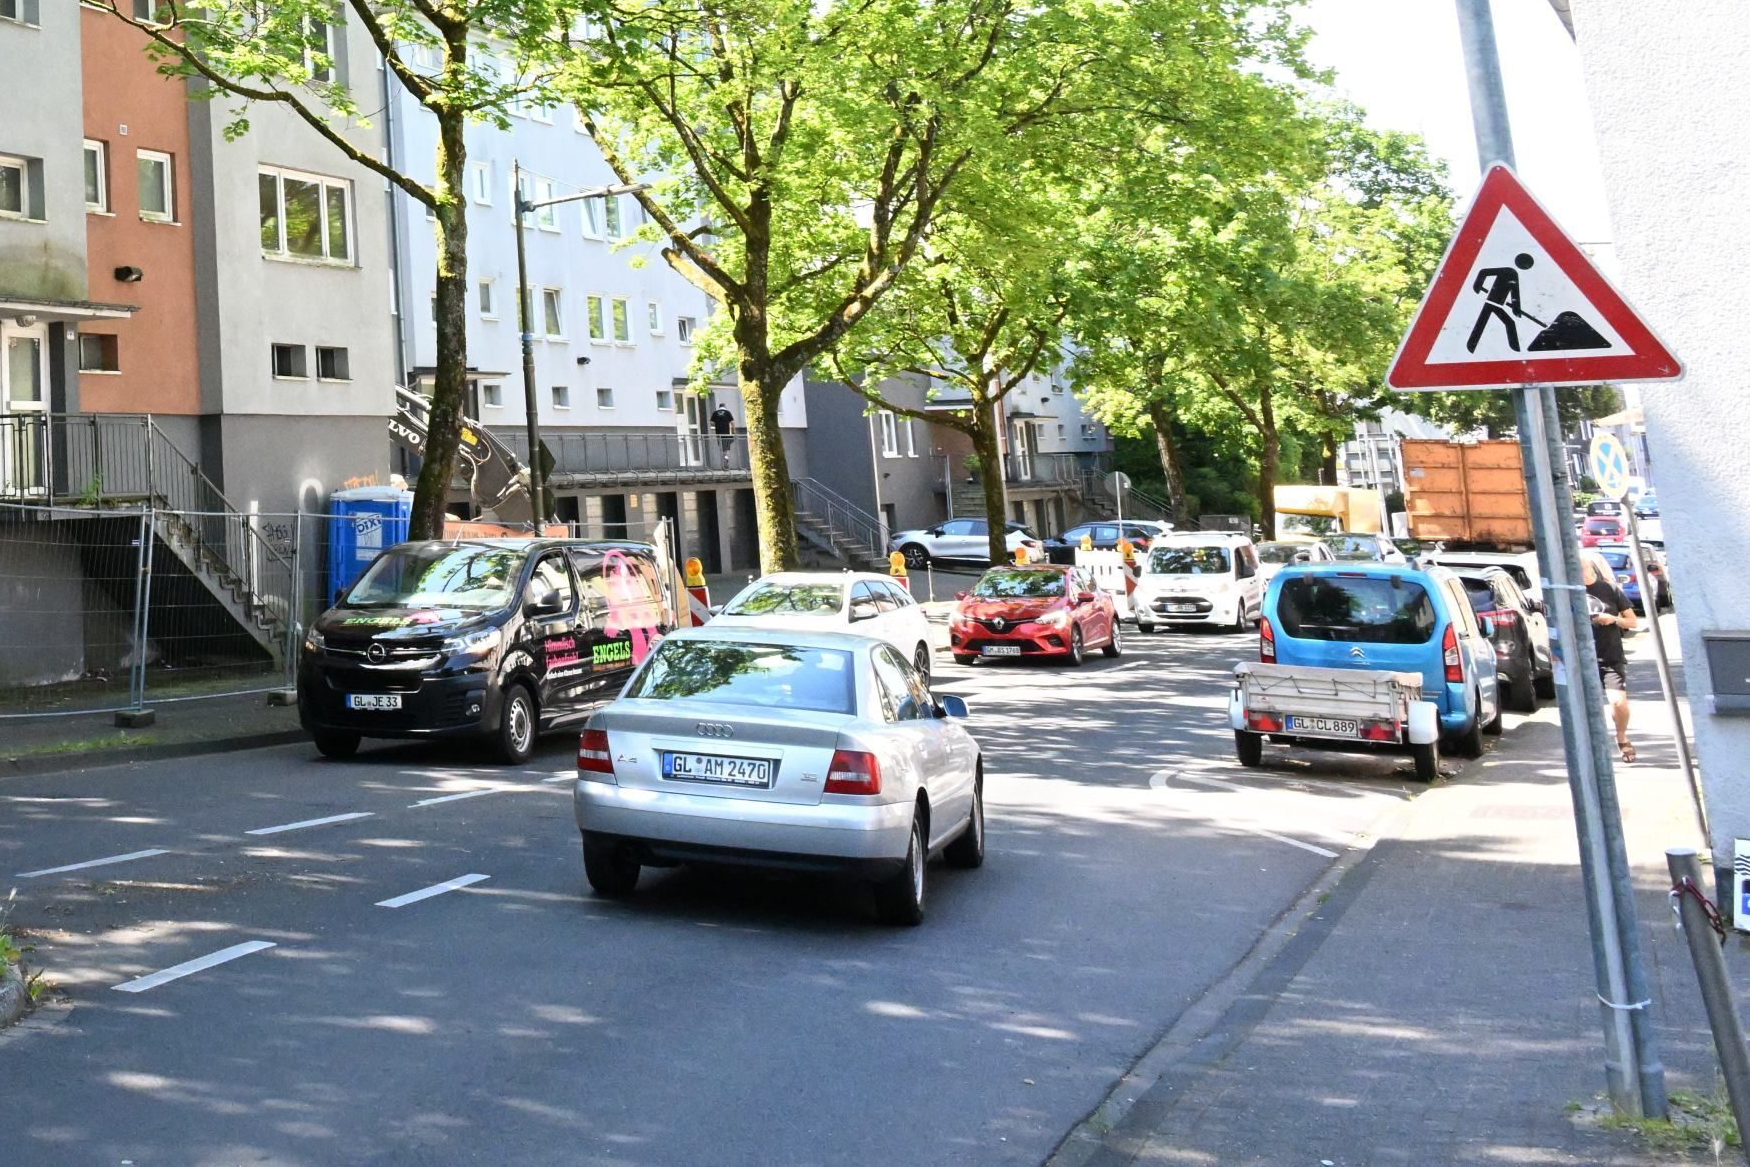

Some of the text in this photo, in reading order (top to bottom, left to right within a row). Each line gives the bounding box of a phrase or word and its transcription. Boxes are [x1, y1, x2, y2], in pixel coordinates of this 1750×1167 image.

[388, 418, 421, 444] LVO
[592, 640, 630, 665] ENGELS
[354, 696, 398, 707] GL JE 33
[1293, 717, 1355, 733] GL CL 889
[673, 756, 692, 773] GL
[704, 758, 724, 776] AM
[727, 760, 766, 780] 2470
